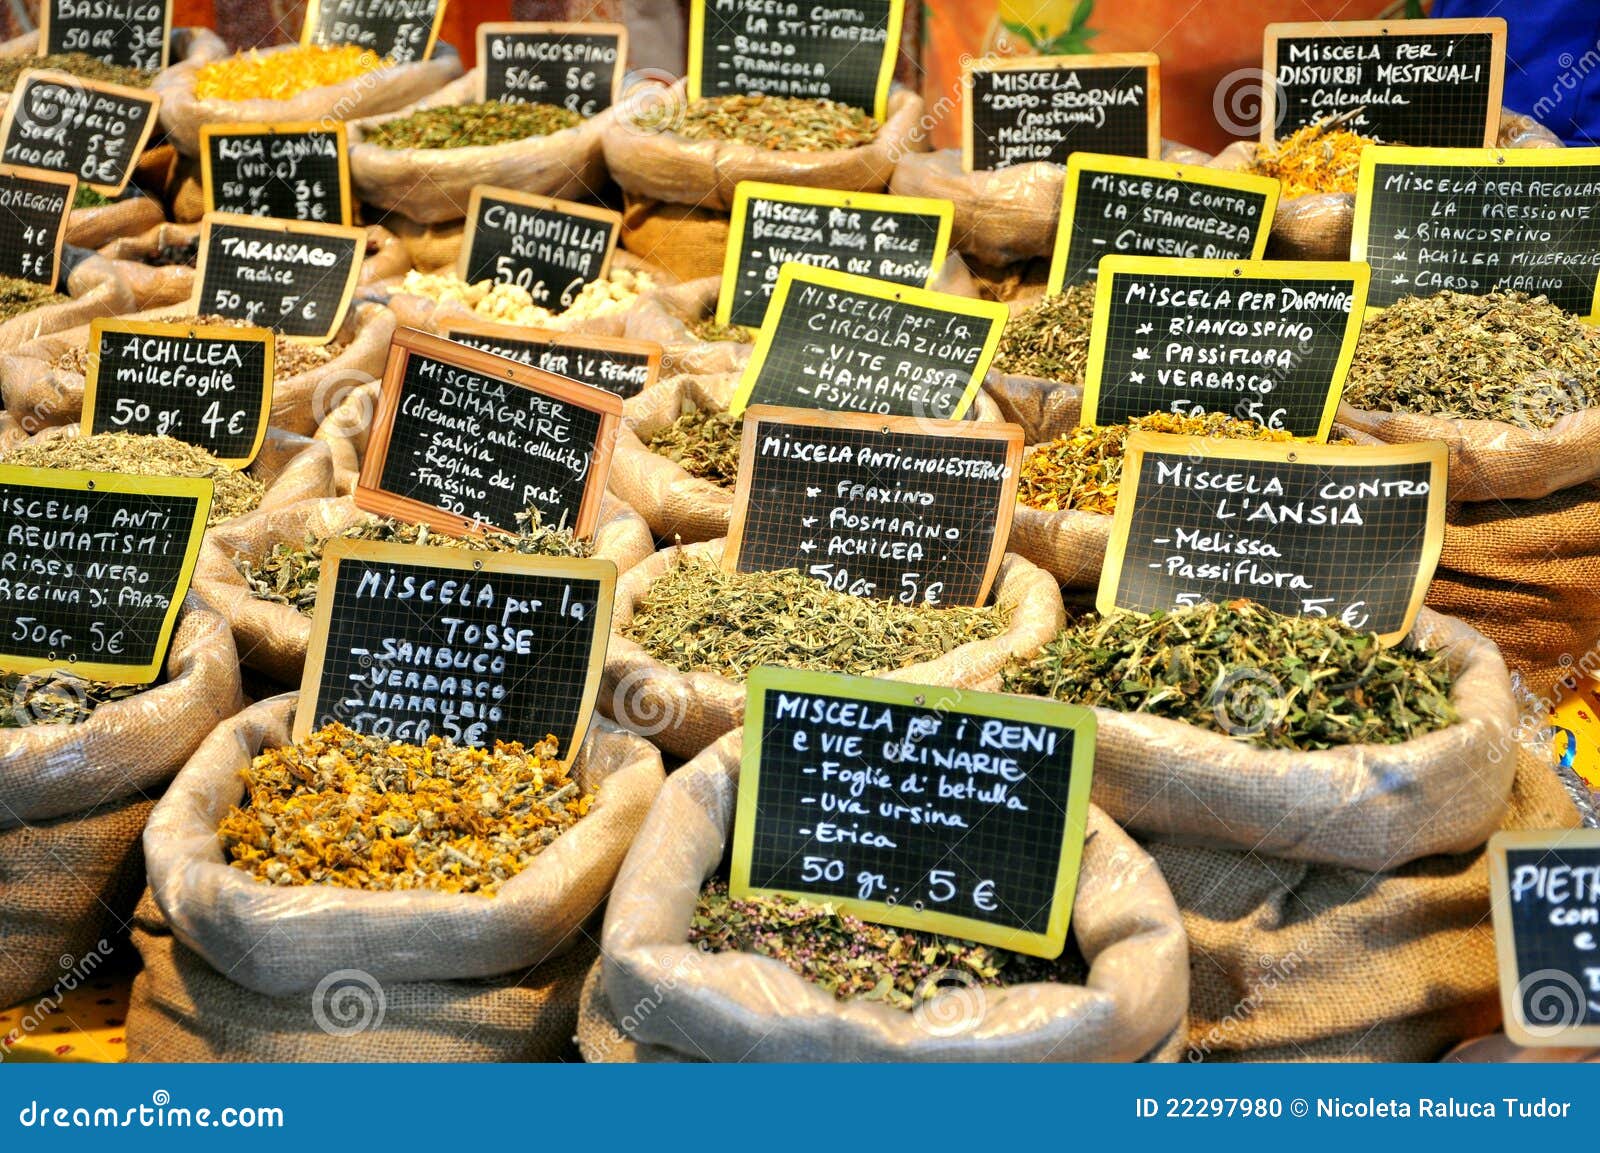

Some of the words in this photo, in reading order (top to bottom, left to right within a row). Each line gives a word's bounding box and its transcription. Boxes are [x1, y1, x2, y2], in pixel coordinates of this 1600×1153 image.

[57, 0, 161, 21] BASILICO
[746, 15, 769, 35] LA
[491, 35, 618, 64] BIANCOSPINO
[734, 35, 796, 57] BOLDO
[1289, 42, 1381, 63] MISCELA
[1396, 43, 1438, 61] PER
[732, 55, 825, 77] FRANGOLA
[991, 71, 1082, 92] MISCELA
[1276, 62, 1362, 86] DISTURBI
[1377, 63, 1481, 86] MESTRUALI
[735, 73, 831, 95] ROSMARINO
[218, 137, 265, 161] ROSA
[999, 126, 1067, 144] Melissa
[1091, 174, 1180, 202] MISCELA
[1189, 190, 1257, 217] CONTRO
[1384, 171, 1477, 195] MISCELA
[1485, 181, 1523, 196] PER
[752, 199, 819, 226] MISCELA
[828, 207, 862, 230] PER
[870, 215, 899, 233] LA
[1103, 202, 1128, 220] LA
[1142, 206, 1251, 244] STANCHEZZA
[1430, 201, 1457, 217] LA
[1482, 203, 1592, 221] PRESSIONE
[483, 204, 606, 254] CAMOMILLA
[1114, 229, 1196, 260] GINSENG
[1416, 221, 1552, 243] BIANCOSPINO
[220, 237, 337, 267] TARASSACO
[510, 233, 592, 277] ROMANA
[1418, 247, 1500, 266] ACHILEA
[236, 264, 295, 285] radice
[1414, 270, 1480, 290] CARDO
[1497, 274, 1563, 290] MARINO
[798, 285, 893, 322] MISCELA
[1125, 282, 1232, 310] MISCELA
[1237, 291, 1277, 312] PER
[1279, 285, 1358, 314] DORMIRE
[807, 313, 983, 365] CIRCOLAZIONE
[1168, 314, 1314, 343] BIANCOSPINO
[121, 336, 243, 368] ACHILLEA
[829, 343, 886, 371] VITE
[895, 361, 958, 389] ROSSA
[1165, 342, 1292, 369] PASSIFLORA
[116, 363, 236, 397] millefoglie
[418, 359, 507, 403] MISCELA
[529, 396, 572, 423] PER
[818, 362, 952, 411] HAMAMELIS
[1157, 368, 1274, 394] VERBASCO
[439, 386, 571, 444] DIMAGRIRE
[813, 382, 891, 416] PSYLLIO
[425, 446, 484, 480] Regina
[488, 468, 518, 492] dei
[761, 433, 854, 464] MISCELA
[857, 447, 1012, 481] ANTICHOLESTEROLO
[836, 480, 935, 506] FRAXINO
[1155, 460, 1285, 497] MISCELA
[1318, 477, 1431, 500] CONTRO
[2, 488, 90, 525] ISCELA
[111, 507, 172, 531] ANTI
[828, 506, 960, 541] ROSMARINO
[1215, 497, 1364, 527] L'ANSIA
[7, 524, 173, 555] REUMATISMI
[827, 535, 924, 563] ACHILEA
[1176, 526, 1283, 558] Melissa
[1, 551, 74, 579] RIBES
[86, 561, 150, 585] NERO
[1166, 555, 1313, 590] Passiflora
[0, 577, 80, 605] REGINA
[118, 585, 170, 610] PRATO
[355, 568, 494, 609] MISCELA
[501, 595, 543, 628] per
[560, 584, 585, 622] la
[440, 617, 534, 655] TOSSE
[373, 637, 506, 675] SAMBUCO
[370, 665, 506, 700] VERBASCO
[368, 689, 502, 723] MARRUBIO
[775, 693, 895, 734] MISCELA
[978, 719, 1057, 757] RENI
[820, 732, 863, 758] VIE
[883, 740, 1028, 783] URINARIE
[820, 760, 892, 797] Foglie
[937, 775, 1029, 812] betulla
[878, 802, 969, 829] ursina
[814, 822, 898, 850] Erica
[800, 856, 845, 883] 50
